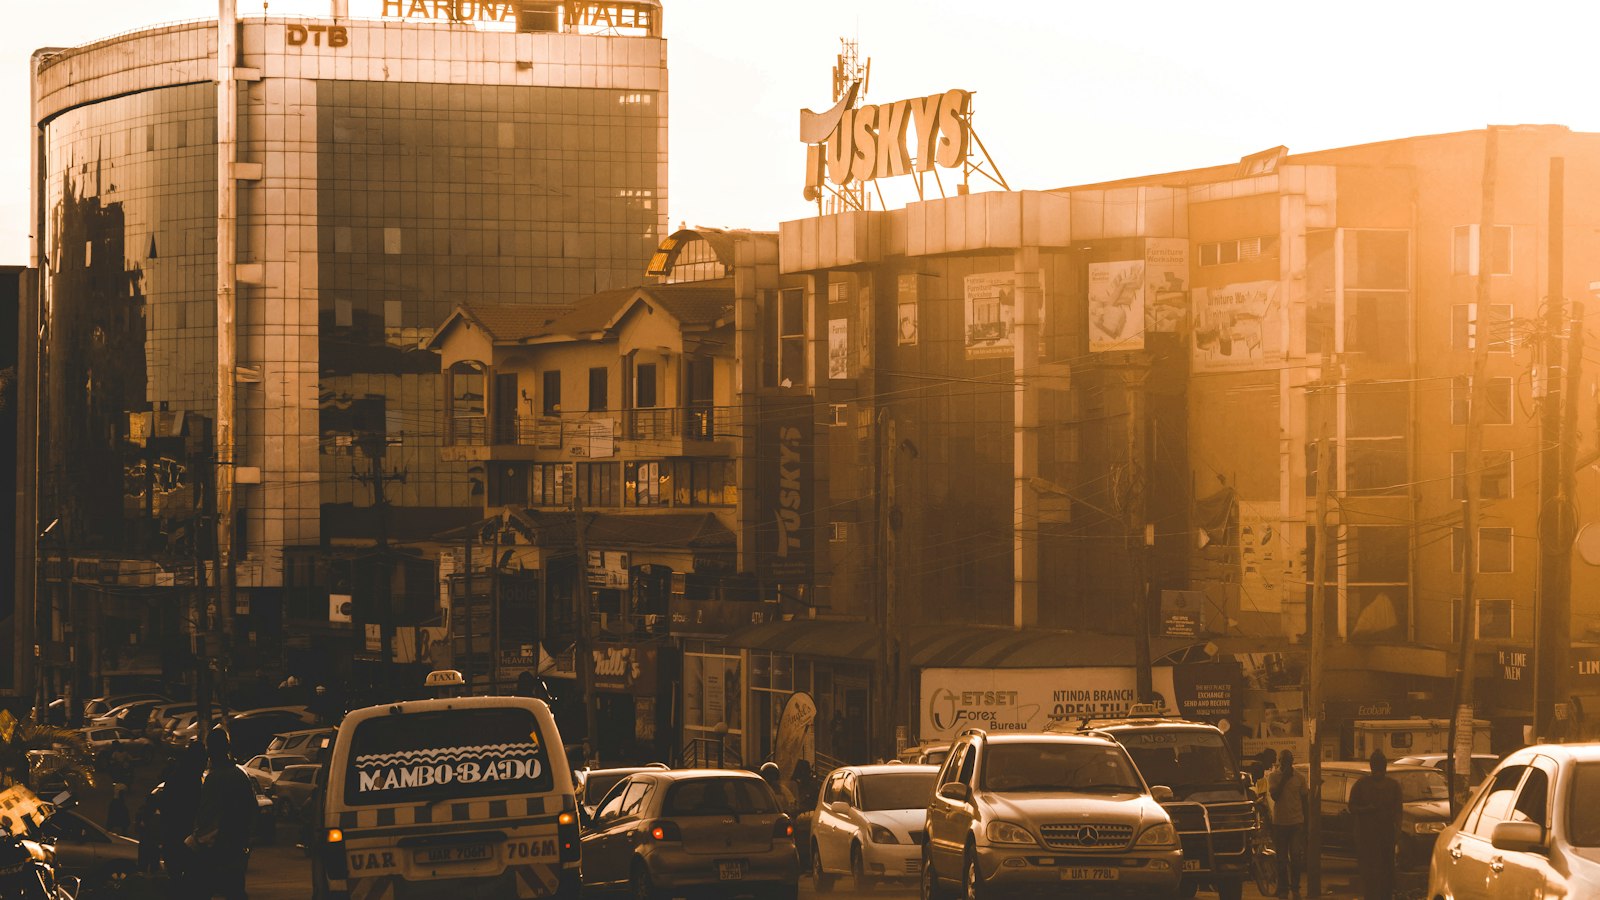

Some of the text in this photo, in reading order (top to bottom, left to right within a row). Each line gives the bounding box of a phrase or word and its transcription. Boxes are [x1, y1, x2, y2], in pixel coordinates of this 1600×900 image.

[382, 0, 517, 23] HARUNA
[287, 25, 349, 47] DTB
[800, 80, 970, 187] TUSKYS
[1146, 247, 1184, 256] Furniture
[1146, 255, 1184, 263] Workshop
[1207, 294, 1234, 307] urniture
[501, 656, 533, 665] HEAVEN
[432, 673, 456, 682] TAXI
[1503, 666, 1521, 680] MEN
[1053, 689, 1134, 702] NTINDA BRANCH
[1358, 703, 1392, 716] Ecobank
[954, 709, 997, 724] Forex
[990, 720, 1038, 731] Bureau
[507, 840, 557, 859] 706M
[350, 852, 396, 871] UAR
[1071, 869, 1088, 879] UAT
